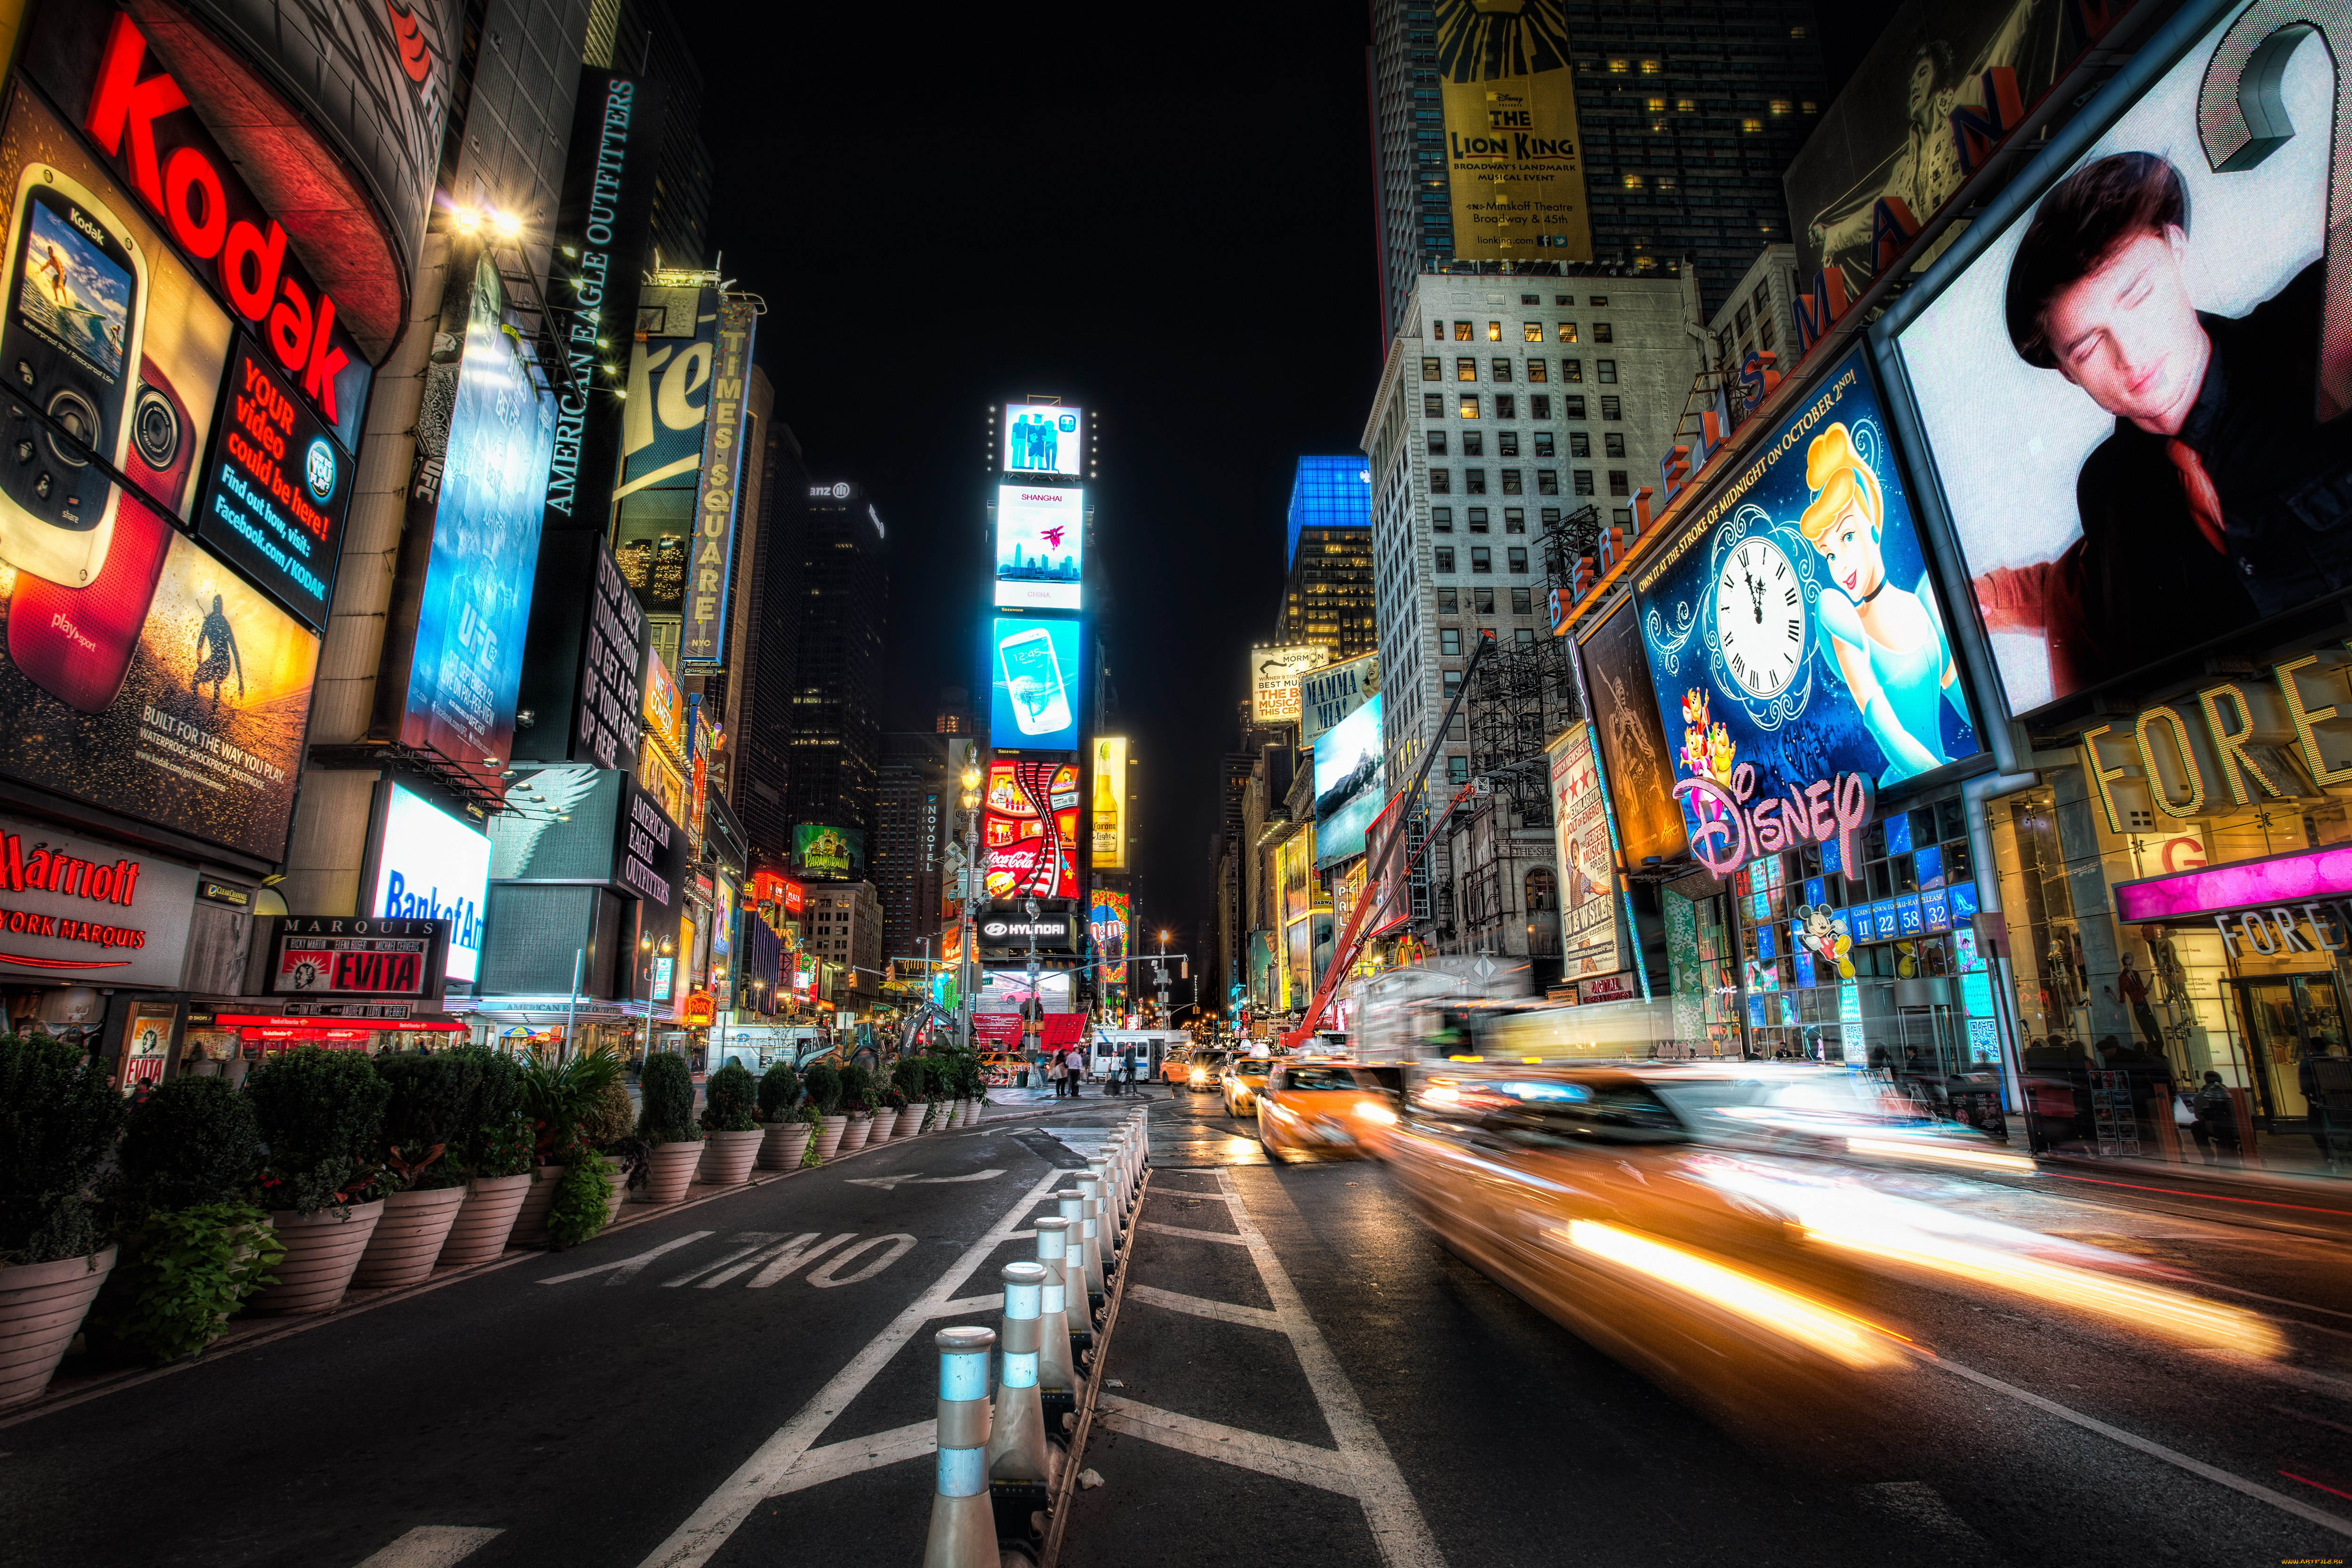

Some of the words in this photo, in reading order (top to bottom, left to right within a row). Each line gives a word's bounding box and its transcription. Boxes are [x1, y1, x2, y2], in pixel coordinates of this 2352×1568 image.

[1489, 111, 1531, 126] THE
[586, 80, 634, 245] OUTFITTERS
[1451, 132, 1509, 159] LION
[1516, 133, 1573, 160] KING
[84, 11, 350, 426] Kodak
[1473, 215, 1528, 225] Broadway
[1531, 215, 1540, 223] &
[1544, 215, 1567, 224] 45th
[1486, 201, 1530, 212] Minskoff
[1534, 202, 1573, 212] Theatre
[70, 207, 104, 246] Kodak
[1478, 236, 1534, 246] lionking.com
[571, 251, 609, 350] EAGLE
[245, 357, 294, 436] YOUR
[715, 331, 746, 450] TIMES
[237, 395, 284, 460] video
[546, 349, 594, 516] AMERICAN
[228, 433, 273, 486] could
[271, 467, 291, 505] be
[291, 486, 329, 541] here!
[415, 460, 444, 504] UFC
[810, 487, 831, 496] anz
[1021, 493, 1062, 502] SHANGHAI
[1639, 575, 1653, 593] OWN
[1652, 569, 1660, 581] IT
[1659, 557, 1667, 573] AT
[1667, 546, 1680, 566] THE
[1678, 519, 1708, 553] STROKE
[1707, 505, 1719, 524] OF
[1719, 457, 1768, 516] MIDNIGHT
[1767, 445, 1782, 466] ON
[1782, 394, 1835, 450] OCTOBER
[1832, 368, 1857, 401] 2ND!
[222, 464, 247, 500] Find
[246, 491, 264, 516] out
[264, 503, 286, 539] how,
[288, 529, 310, 557] visit:
[215, 494, 325, 601] Facebook.com/KODAK
[695, 463, 730, 621] SQUARE
[599, 548, 621, 607] STOP
[620, 587, 641, 644] BACK
[51, 613, 77, 639] play
[77, 634, 96, 653] sport
[458, 601, 497, 670] UFC
[488, 645, 498, 662] 152
[596, 588, 639, 678] TOMORROW
[590, 626, 603, 667] TO
[603, 646, 620, 689] GET
[618, 669, 625, 697] A
[625, 677, 638, 717] PIC
[1013, 648, 1041, 662] 12:45
[454, 677, 462, 699] ON
[461, 683, 495, 727] PAY-PER-VIEW
[459, 661, 487, 700] SEPTEMBER
[485, 688, 494, 708] 22
[655, 670, 665, 700] WE
[1259, 698, 1299, 709] MUSICA
[1305, 669, 1358, 707] MAMMA
[586, 666, 598, 705] OF
[599, 681, 620, 734] YOUR
[620, 709, 639, 756] FACE
[650, 690, 673, 734] COMEDY
[1259, 708, 1280, 716] THIS
[1317, 698, 1348, 731] MIA!
[143, 705, 176, 732] BUILT
[176, 721, 199, 744] FOR
[200, 731, 221, 754] THE
[221, 740, 245, 764] WAY
[244, 752, 265, 774] YOU
[264, 763, 286, 784] PLAY.
[580, 704, 596, 748] UP
[594, 721, 618, 771] HERE.
[2080, 639, 2352, 834] FORE
[135, 749, 227, 793] www.kodak.com/go/videocameras
[139, 726, 189, 756] WATERPROOF.
[189, 751, 232, 776] SHOCKPROOF.
[231, 768, 266, 791] DUSTPROOF.
[1566, 812, 1571, 821] AN
[1571, 785, 1602, 820] EXHILARATIN
[1567, 819, 1577, 837] JOLT
[1578, 818, 1583, 827] OF
[1582, 800, 1603, 824] ENERGY
[631, 794, 671, 851] AMERICAN
[926, 805, 937, 872] NOVOTEL
[1093, 821, 1116, 832] Corona
[1096, 832, 1111, 840] Light
[628, 822, 654, 865] EAGLE
[805, 852, 850, 871] PARANORMAN
[988, 851, 1037, 869] Coca-Cola
[1515, 847, 1535, 856] THE
[384, 869, 442, 919] Bank
[625, 854, 671, 907] OUTFITTERS
[788, 891, 800, 903] PLAZA
[283, 918, 434, 935] MARQUIS
[1564, 893, 1613, 937] NEWSIES
[1853, 903, 1888, 917] COUNTOWN
[1858, 921, 1869, 936] 11
[1878, 915, 1894, 932] 22
[1902, 911, 1920, 929] 58
[1929, 906, 1946, 924] 32
[57, 918, 147, 949] MARQUIS
[290, 938, 307, 949] RICKY
[307, 939, 327, 950] MARTIN
[334, 939, 350, 950] ELENA
[350, 940, 367, 951] ROGER
[375, 940, 396, 951] MICHAEL
[397, 941, 420, 952] CERVERIS
[1009, 924, 1065, 935] HYUNDAI
[335, 952, 414, 991] EVITA
[1591, 977, 1620, 993] DIGITAL
[299, 1004, 309, 1015] TIM
[309, 1004, 322, 1016] RICE
[342, 1005, 365, 1016] ANDREW
[366, 1005, 382, 1017] LLOYD
[384, 1006, 407, 1017] WEBBER
[691, 999, 710, 1013] ROXY
[1101, 1009, 1118, 1025] R
[905, 1022, 918, 1048] DEERE
[126, 1059, 164, 1084] EVITA
